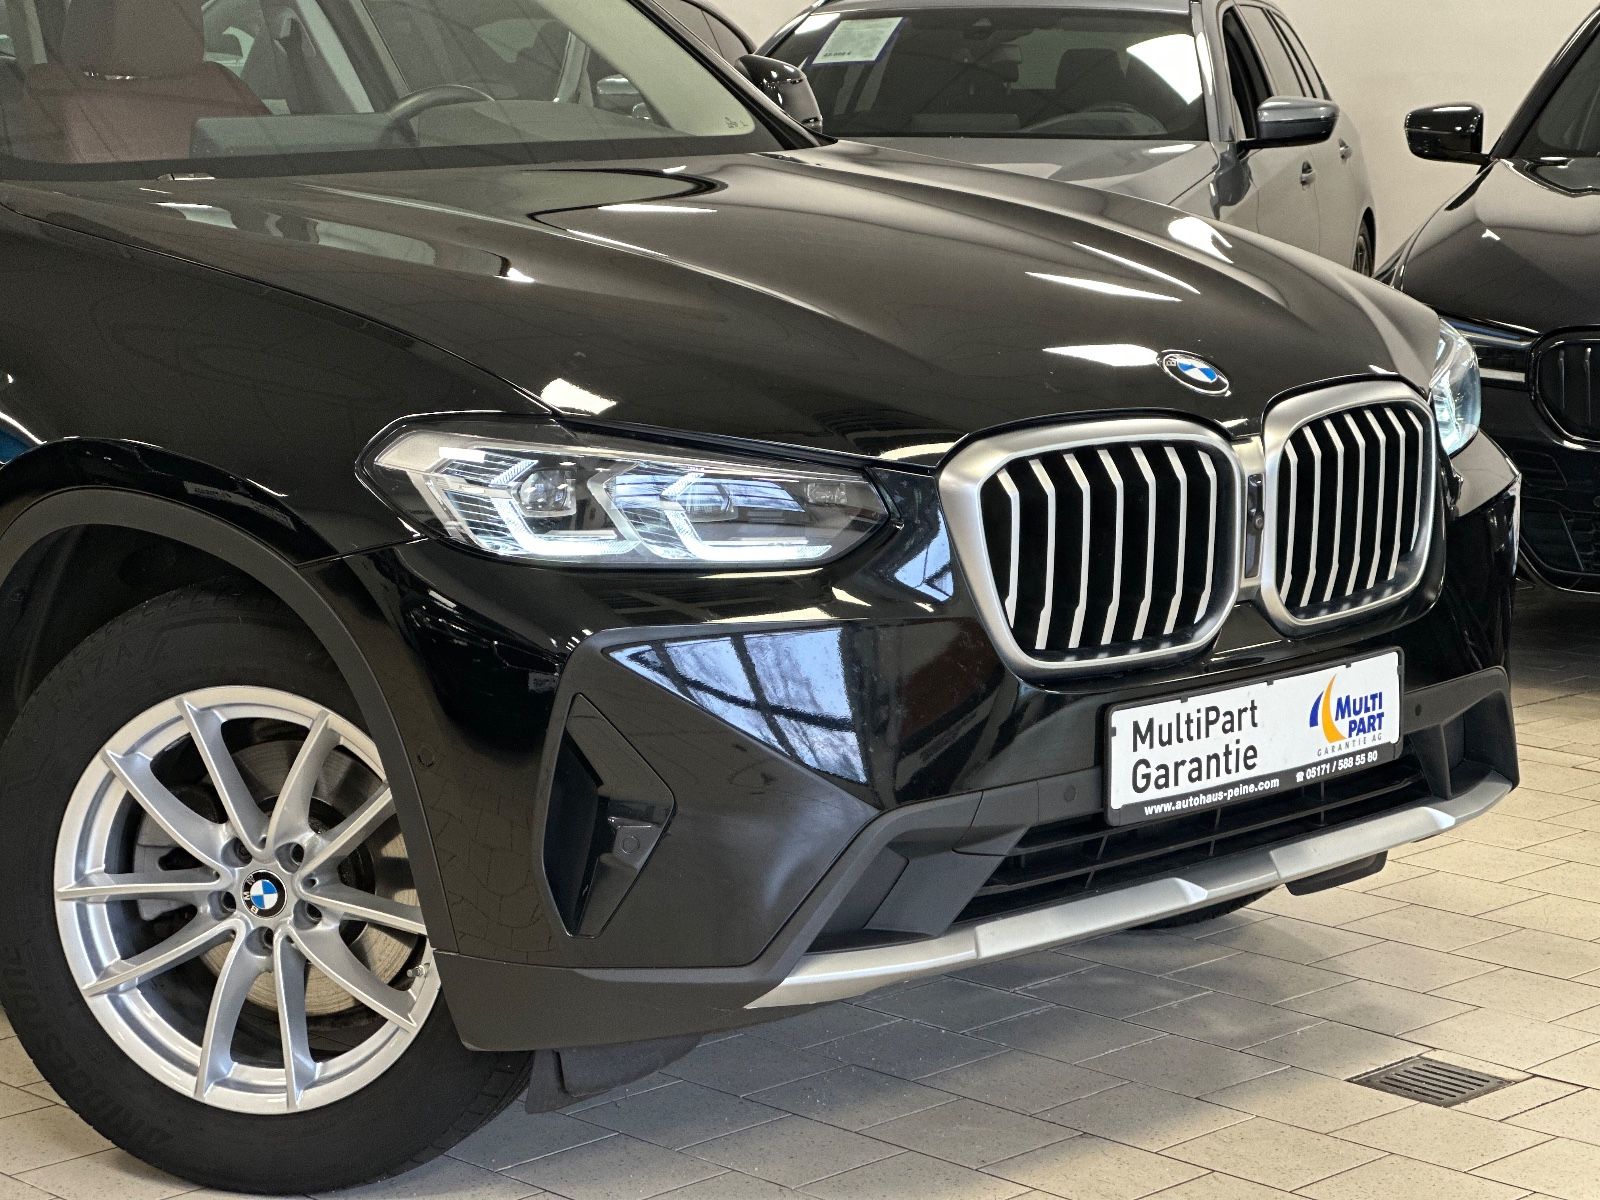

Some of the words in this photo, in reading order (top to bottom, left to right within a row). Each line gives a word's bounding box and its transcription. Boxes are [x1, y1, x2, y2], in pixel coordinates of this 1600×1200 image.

[1334, 691, 1383, 722] MULTI
[1132, 699, 1259, 753] MultiPart
[1348, 711, 1385, 738] PART
[1317, 736, 1367, 757] GARANTIE
[1371, 732, 1383, 743] AG
[1131, 738, 1259, 794] Garantie
[1305, 762, 1330, 780] 05171
[1337, 756, 1354, 771] 588
[1355, 753, 1366, 766] 55
[1367, 750, 1378, 762] 80
[1143, 778, 1280, 816] www.autohaus-peine.com
